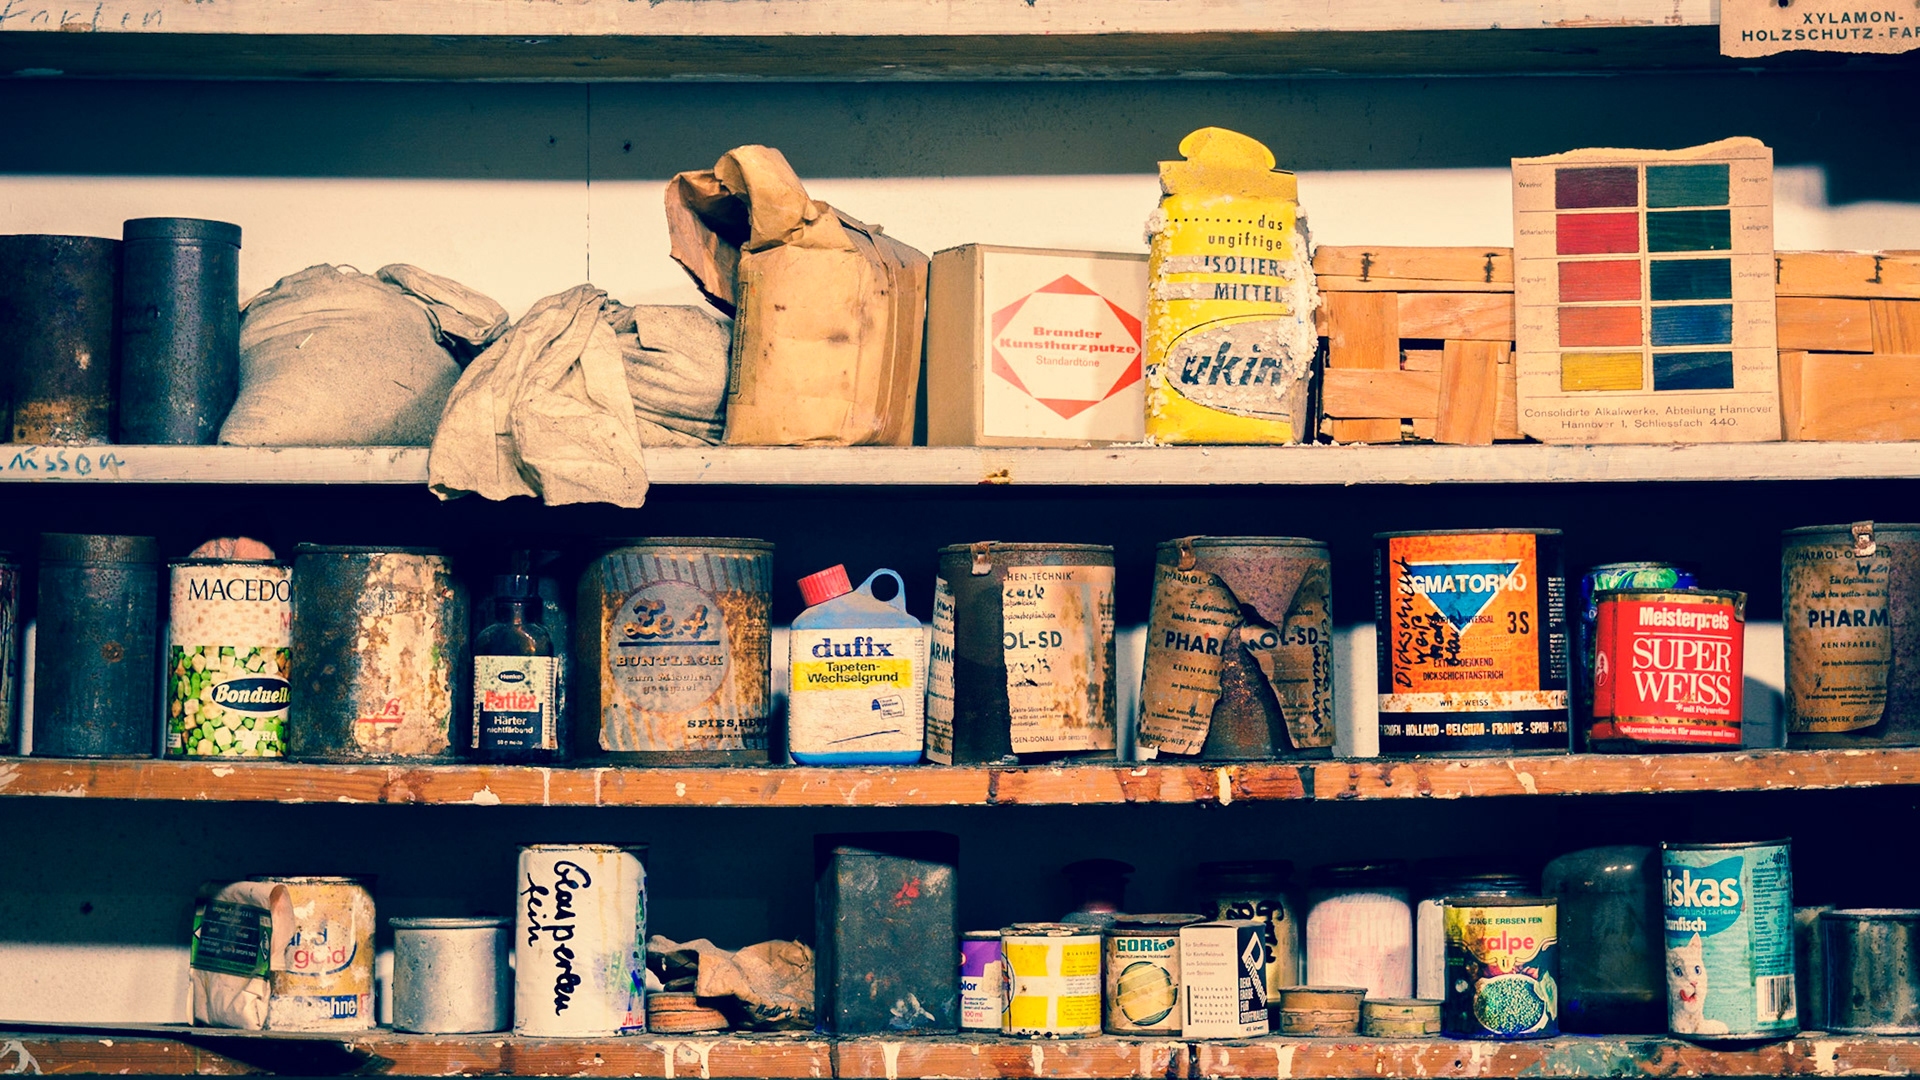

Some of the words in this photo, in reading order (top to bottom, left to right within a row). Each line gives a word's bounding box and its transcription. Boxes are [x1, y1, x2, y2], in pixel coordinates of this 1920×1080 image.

[1803, 11, 1904, 24] XYLAMON-
[1258, 214, 1283, 231] das
[1208, 232, 1283, 252] ungiftige
[1214, 283, 1282, 302] MITTEL
[1033, 326, 1102, 340] Brander
[1000, 337, 1136, 354] Kunstharzputze
[1639, 607, 1729, 630] Meisterpreis
[812, 636, 894, 658] dufix
[1632, 638, 1731, 673] SUPER
[616, 654, 724, 667] BUNTLACK
[826, 661, 880, 672] Tapeten-
[807, 672, 899, 684] Wechselgrund
[1632, 671, 1731, 706] WEISS
[484, 690, 537, 710] Pattex
[494, 716, 527, 726] Härter
[1405, 723, 1440, 736] HOLLAND
[1446, 723, 1485, 735] BELGIUM
[1492, 722, 1524, 734] FRANCE
[1530, 722, 1549, 733] SPAIN
[234, 730, 278, 742] ETRA
